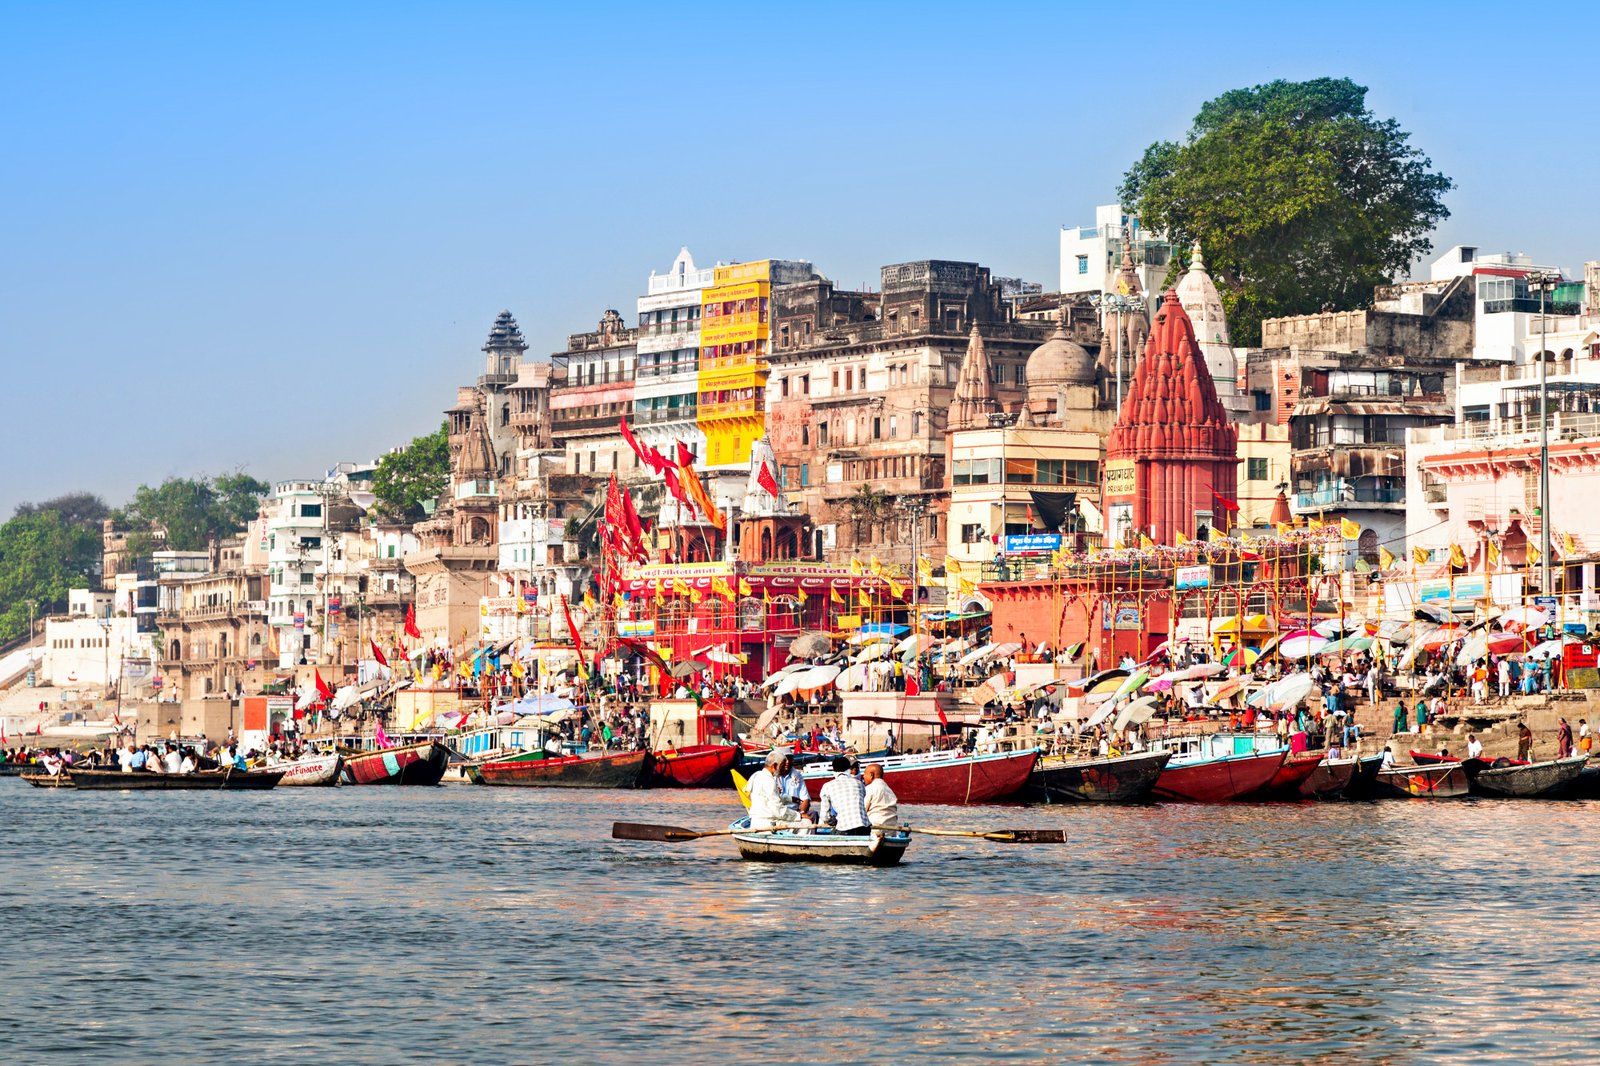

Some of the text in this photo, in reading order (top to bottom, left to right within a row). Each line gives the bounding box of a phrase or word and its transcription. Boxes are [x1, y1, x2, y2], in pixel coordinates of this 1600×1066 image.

[1106, 467, 1135, 482] प्रयाग घाट
[1124, 483, 1135, 491] GHAT
